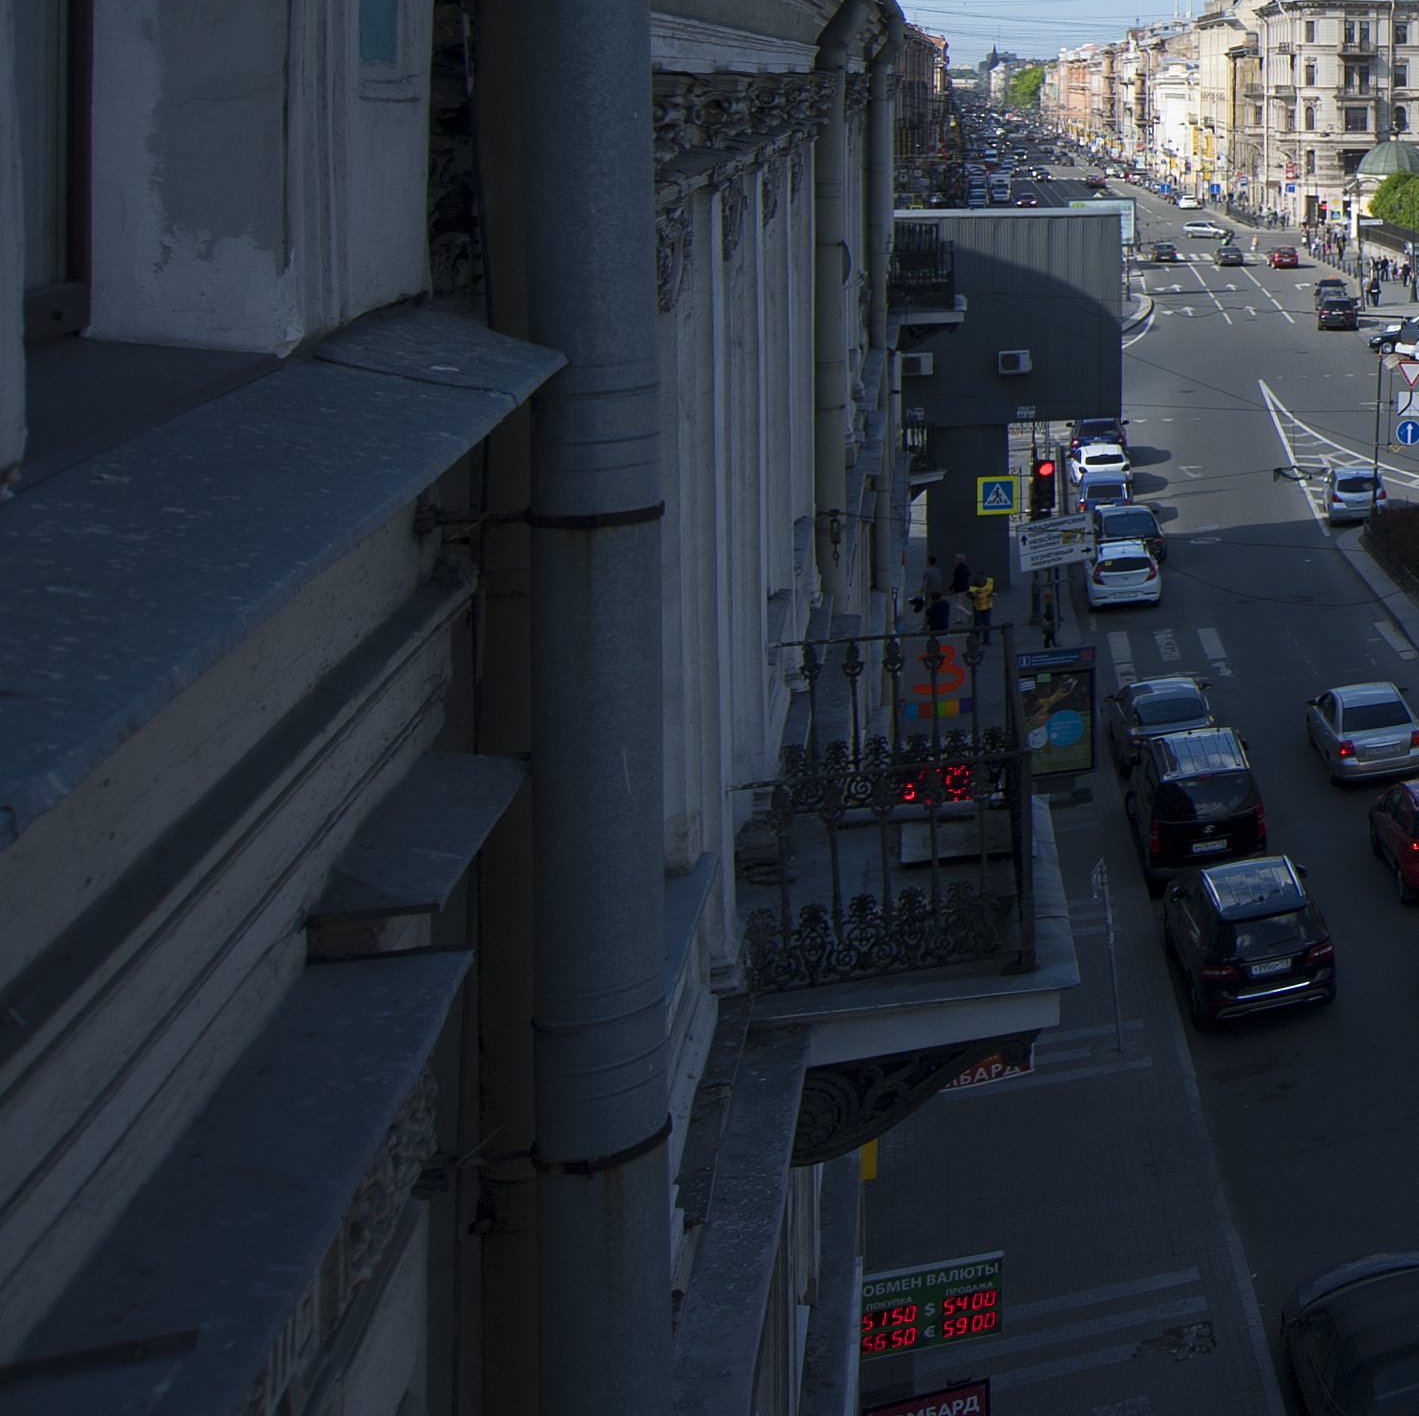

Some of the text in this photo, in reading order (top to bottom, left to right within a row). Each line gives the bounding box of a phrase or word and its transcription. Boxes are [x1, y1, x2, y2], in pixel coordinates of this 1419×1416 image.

[863, 1262, 999, 1297] ОБМЕН ВАЛЮТЫ
[866, 1281, 994, 1311] ПОКУПКА ПРОДАЖА
[924, 1302, 936, 1316] $
[923, 1325, 936, 1338] €
